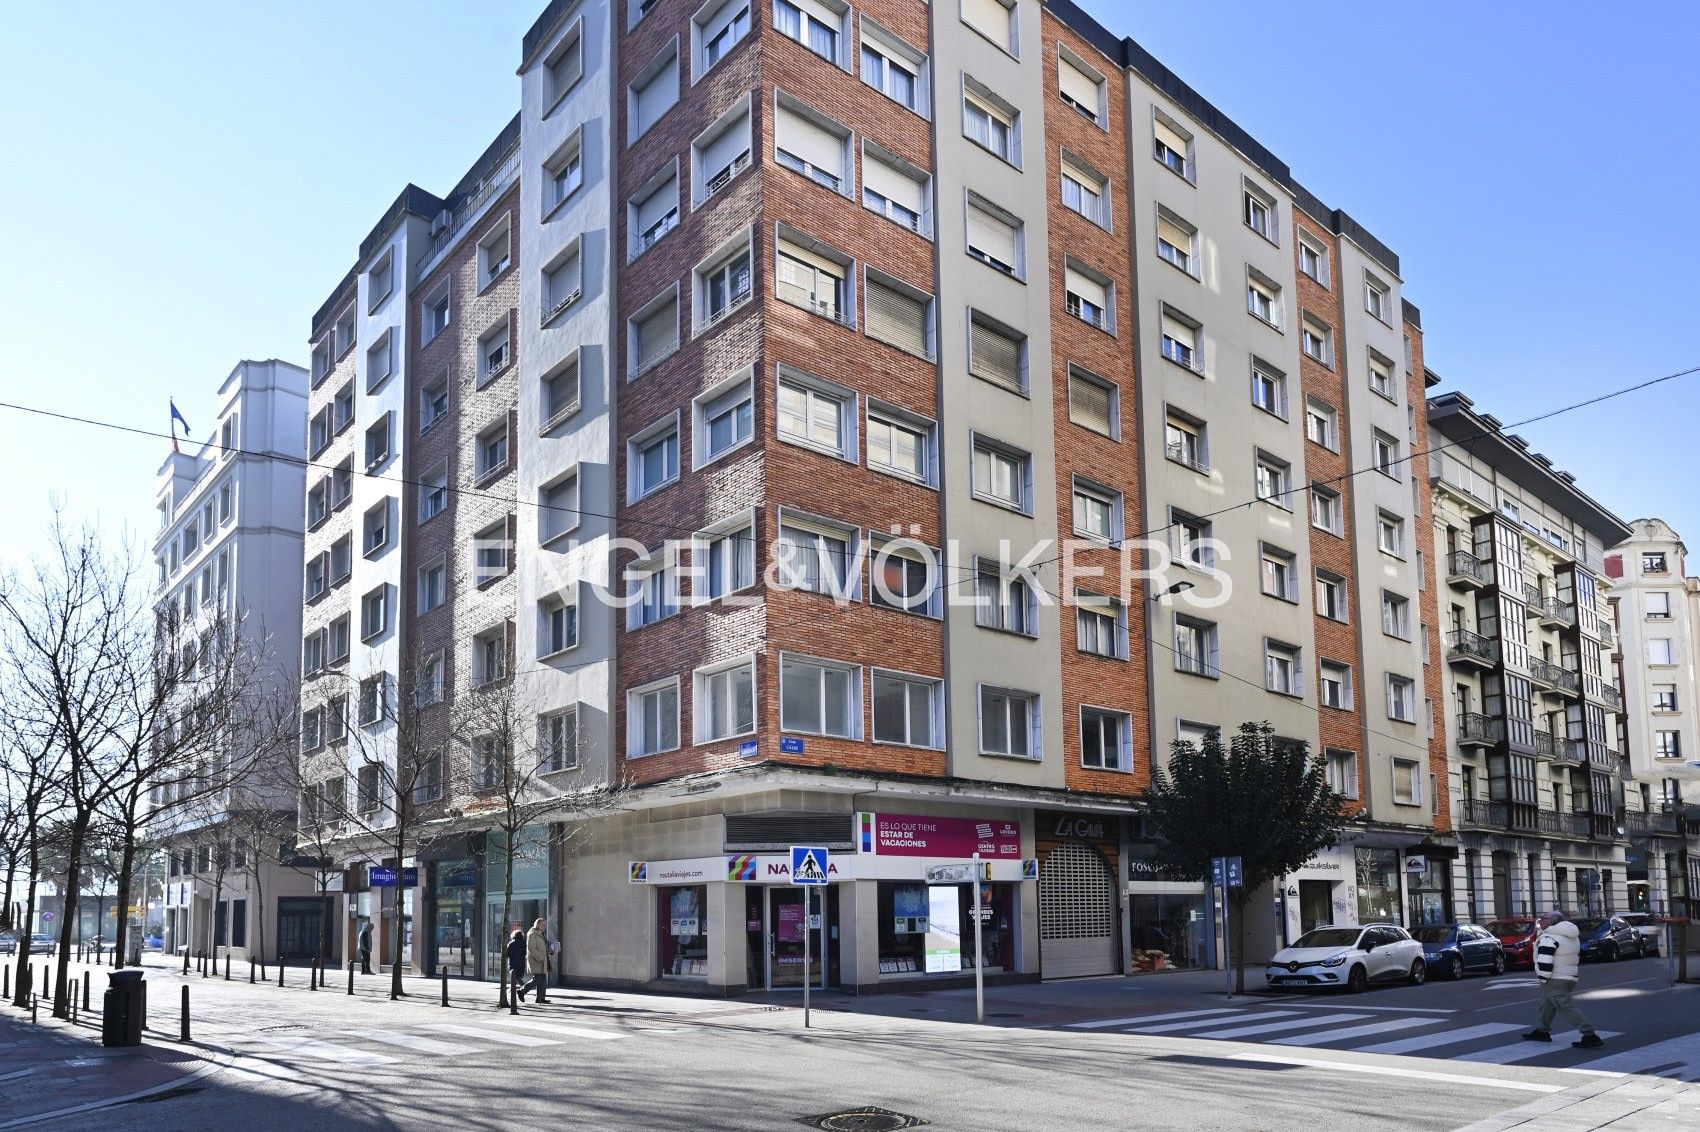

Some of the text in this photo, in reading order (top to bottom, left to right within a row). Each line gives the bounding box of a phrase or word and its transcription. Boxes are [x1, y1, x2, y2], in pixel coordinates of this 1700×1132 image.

[880, 822, 937, 832] ES LO QUE TIENE
[903, 831, 914, 839] DE
[880, 839, 927, 848] VACACIONES
